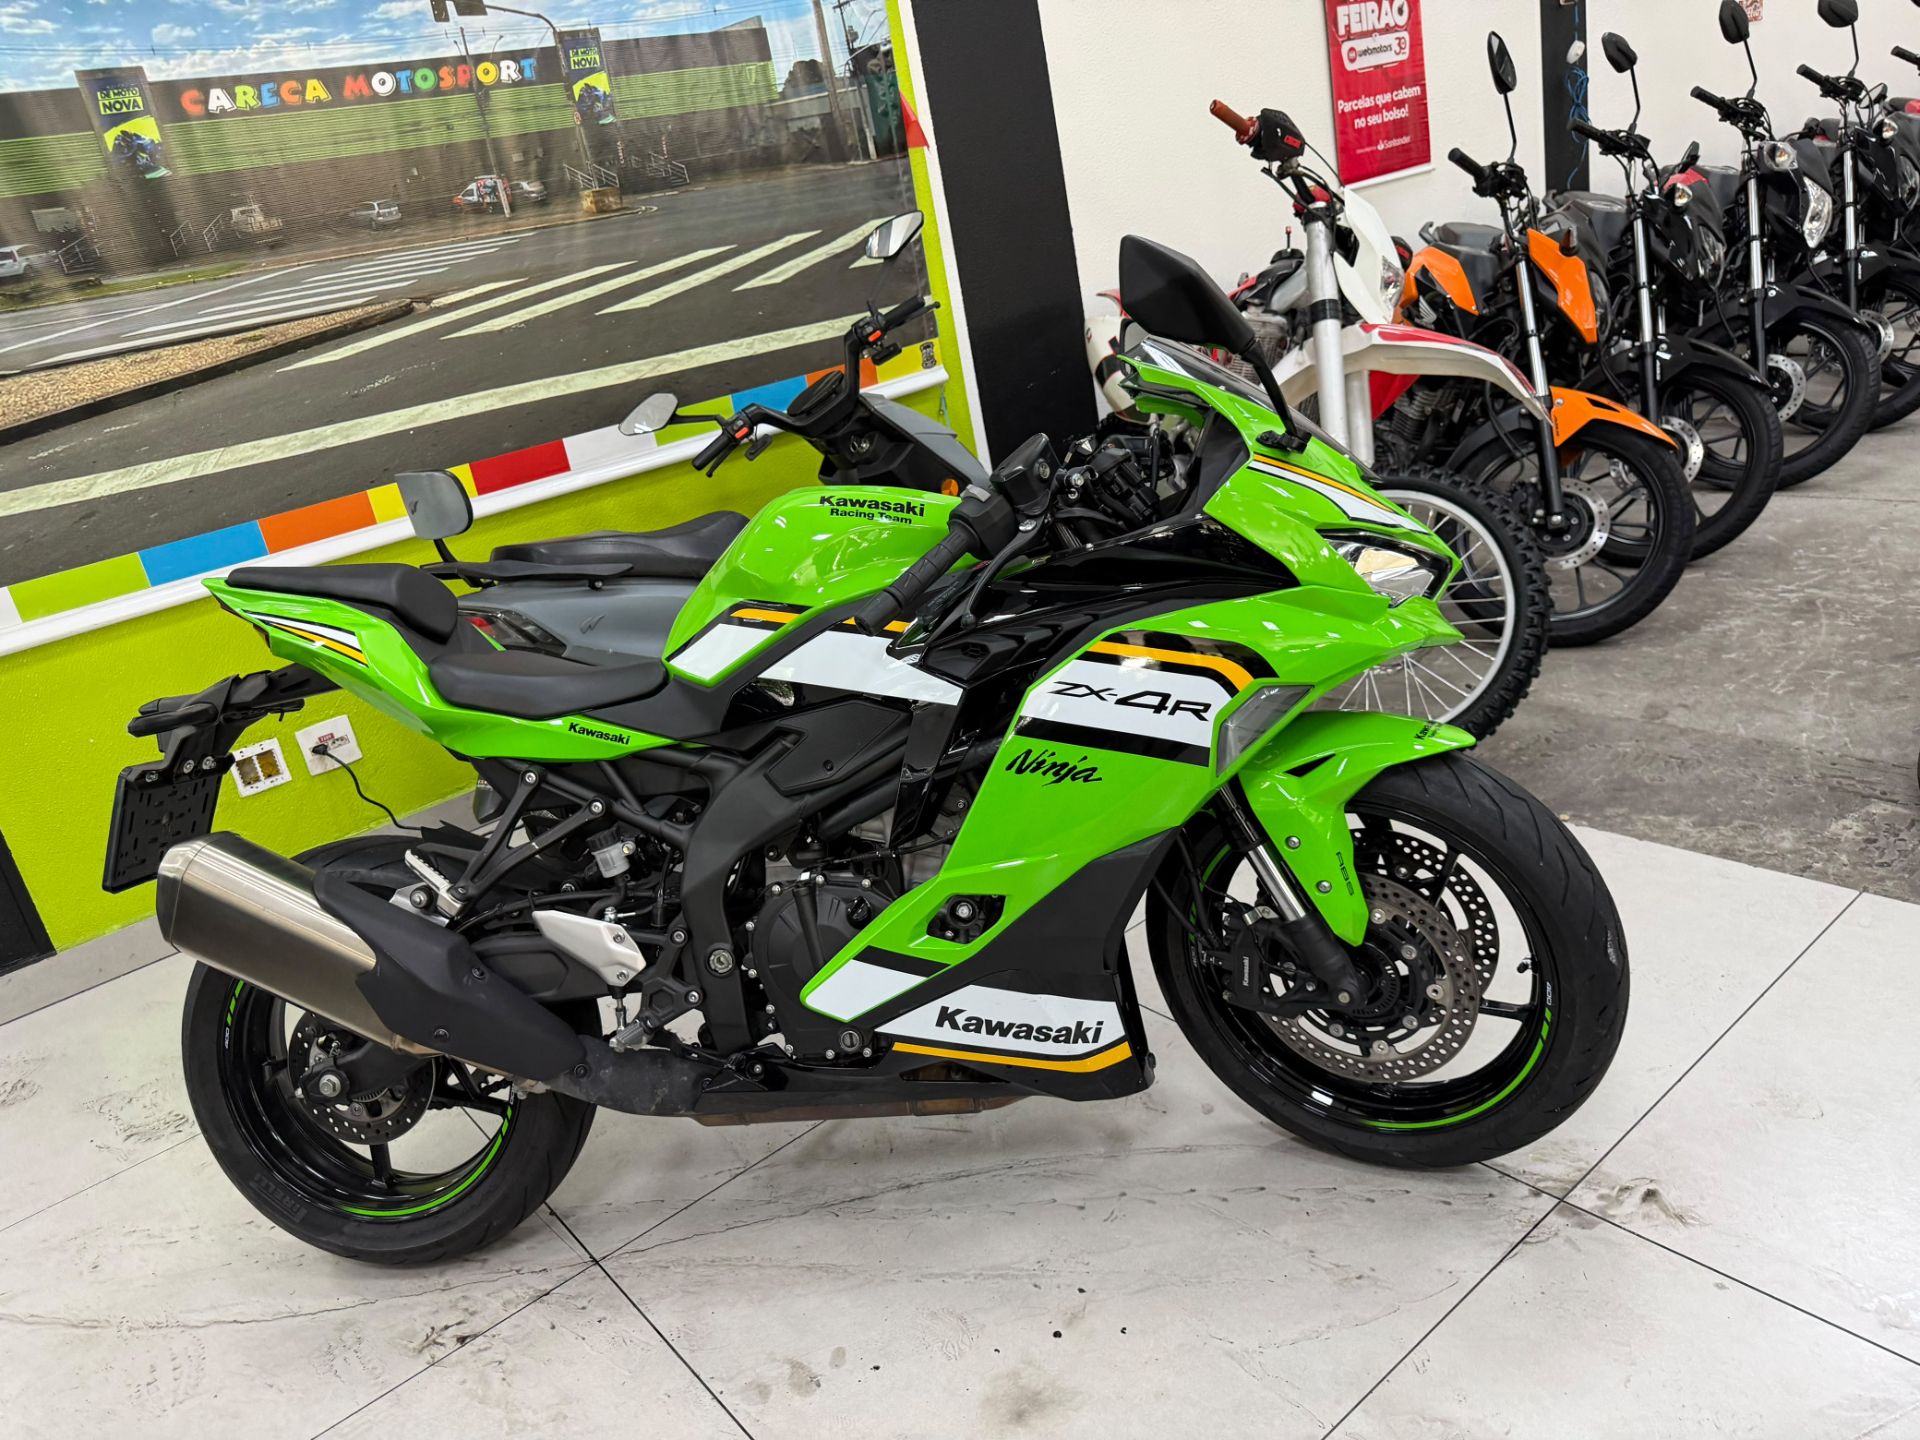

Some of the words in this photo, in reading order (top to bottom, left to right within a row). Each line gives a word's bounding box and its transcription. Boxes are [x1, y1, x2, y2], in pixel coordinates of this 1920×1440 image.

[573, 57, 598, 67] NOVA
[1358, 44, 1393, 57] webmotors
[181, 79, 332, 116] CARECA
[343, 58, 536, 99] MOTOSPORT
[1338, 95, 1375, 113] Parcelas
[1375, 92, 1392, 107] que
[1393, 85, 1421, 100] cabem
[102, 99, 141, 113] NOVA
[1354, 117, 1366, 129] no
[1367, 113, 1382, 125] seu
[1382, 104, 1409, 121] bolso!
[1384, 136, 1411, 149] Santander
[819, 496, 925, 517] Kawasaki
[830, 508, 875, 520] Racing
[877, 512, 912, 524] Team
[1048, 681, 1212, 722] ZX-4R
[568, 722, 631, 745] Kawasaki
[1005, 749, 1103, 787] Ninja
[1336, 851, 1355, 896] ABS
[935, 1006, 1104, 1044] Kawasaki
